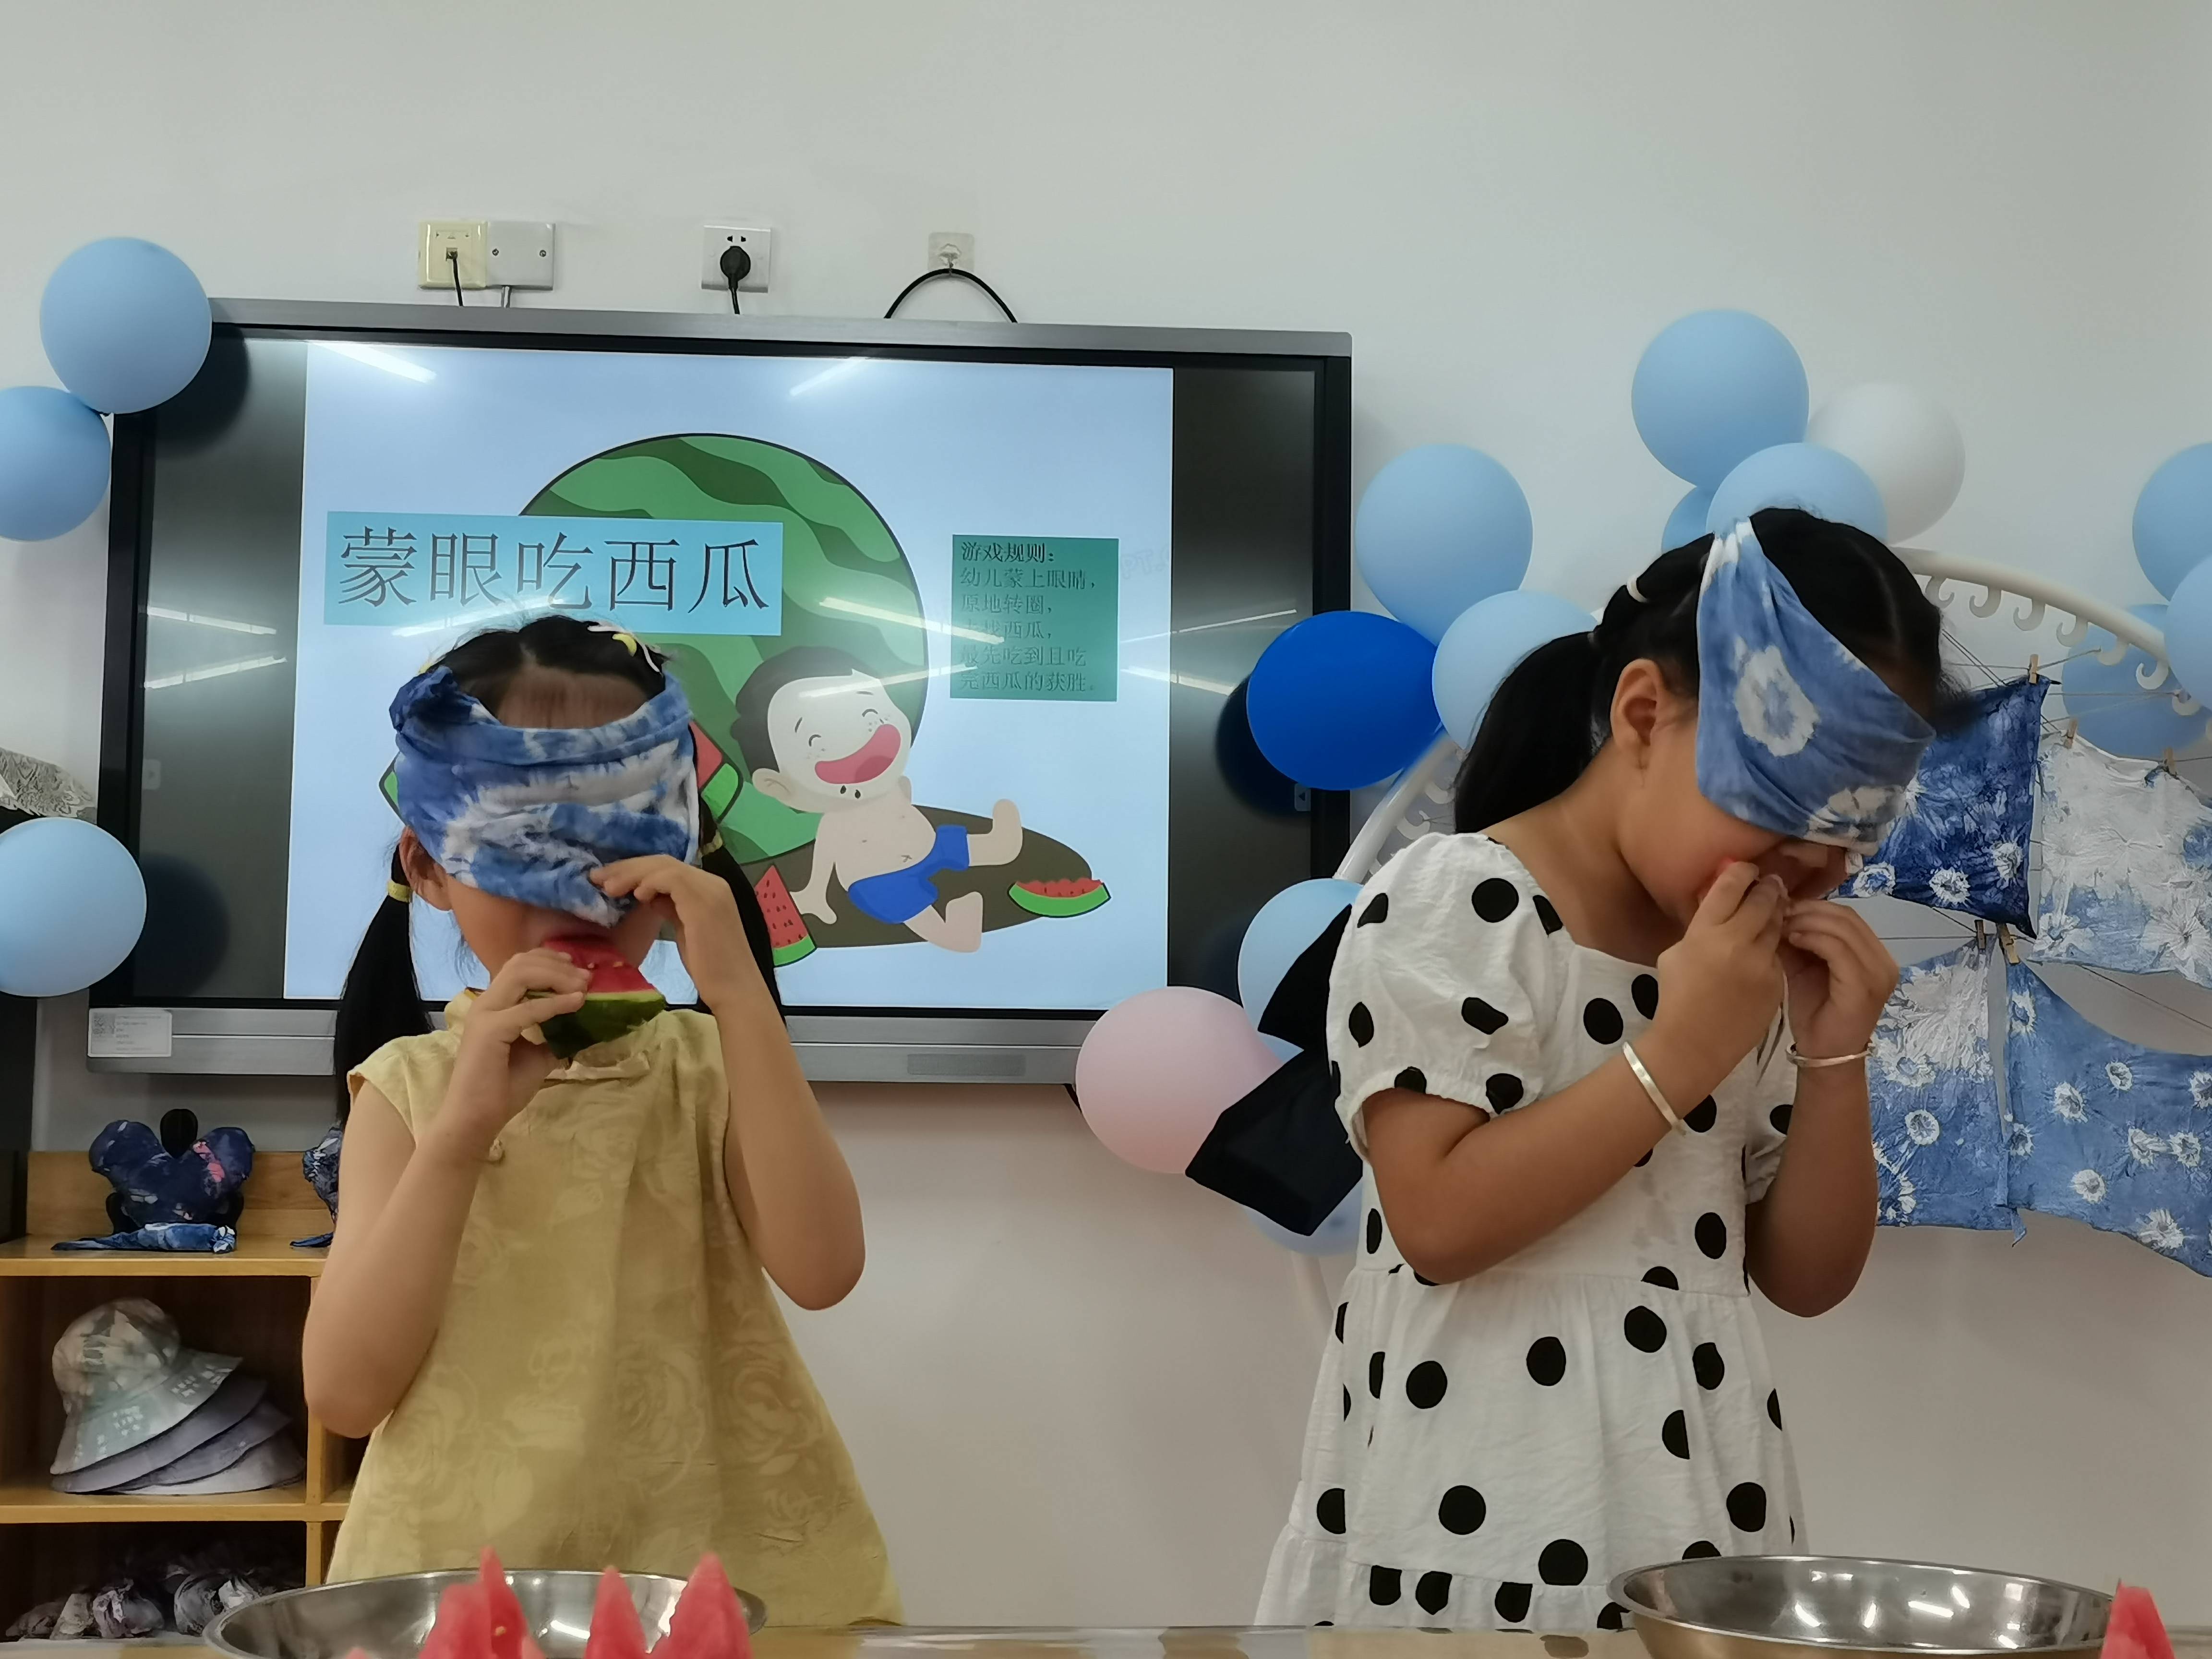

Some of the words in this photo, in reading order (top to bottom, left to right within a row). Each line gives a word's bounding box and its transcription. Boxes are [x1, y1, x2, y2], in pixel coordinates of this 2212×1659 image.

[962, 542, 1055, 563] 游戏规则：
[338, 526, 769, 613] 蒙眼吃西瓜
[962, 594, 1052, 614] 原地转圈，
